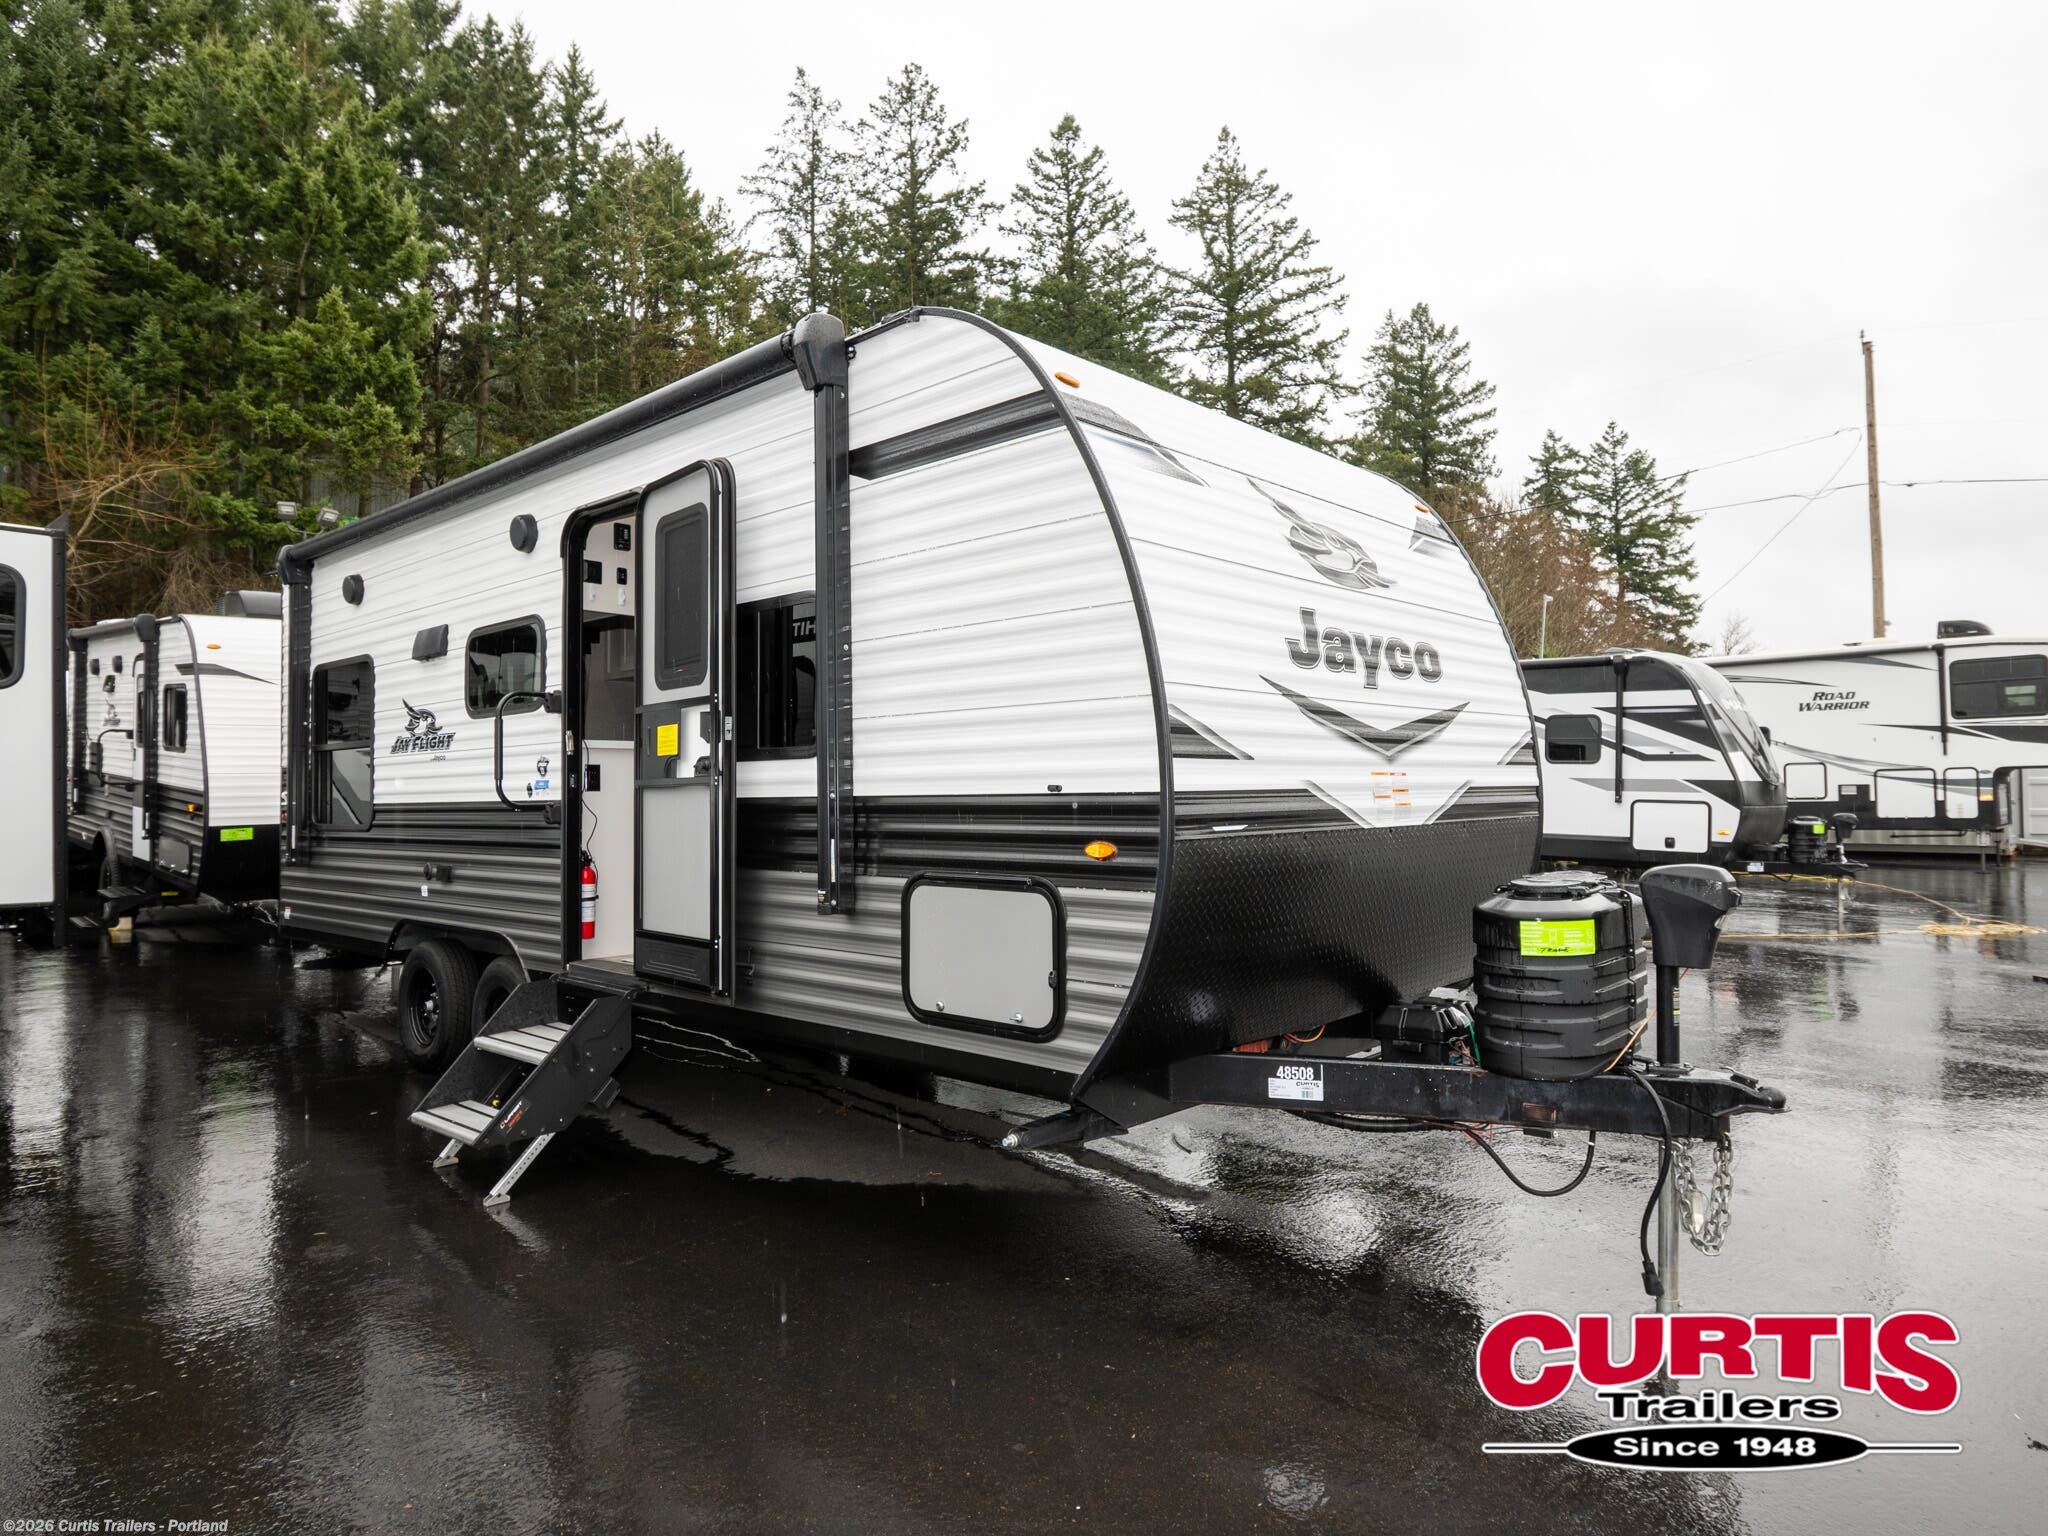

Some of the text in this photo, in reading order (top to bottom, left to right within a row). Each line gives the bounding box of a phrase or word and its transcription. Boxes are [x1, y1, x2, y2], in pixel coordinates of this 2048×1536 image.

[1284, 607, 1444, 689] Jayco
[1812, 691, 1856, 701] ROAD
[1798, 701, 1870, 712] WARRIOR
[390, 732, 456, 754] JAY FLIGHT
[1276, 1065, 1314, 1081] 48508
